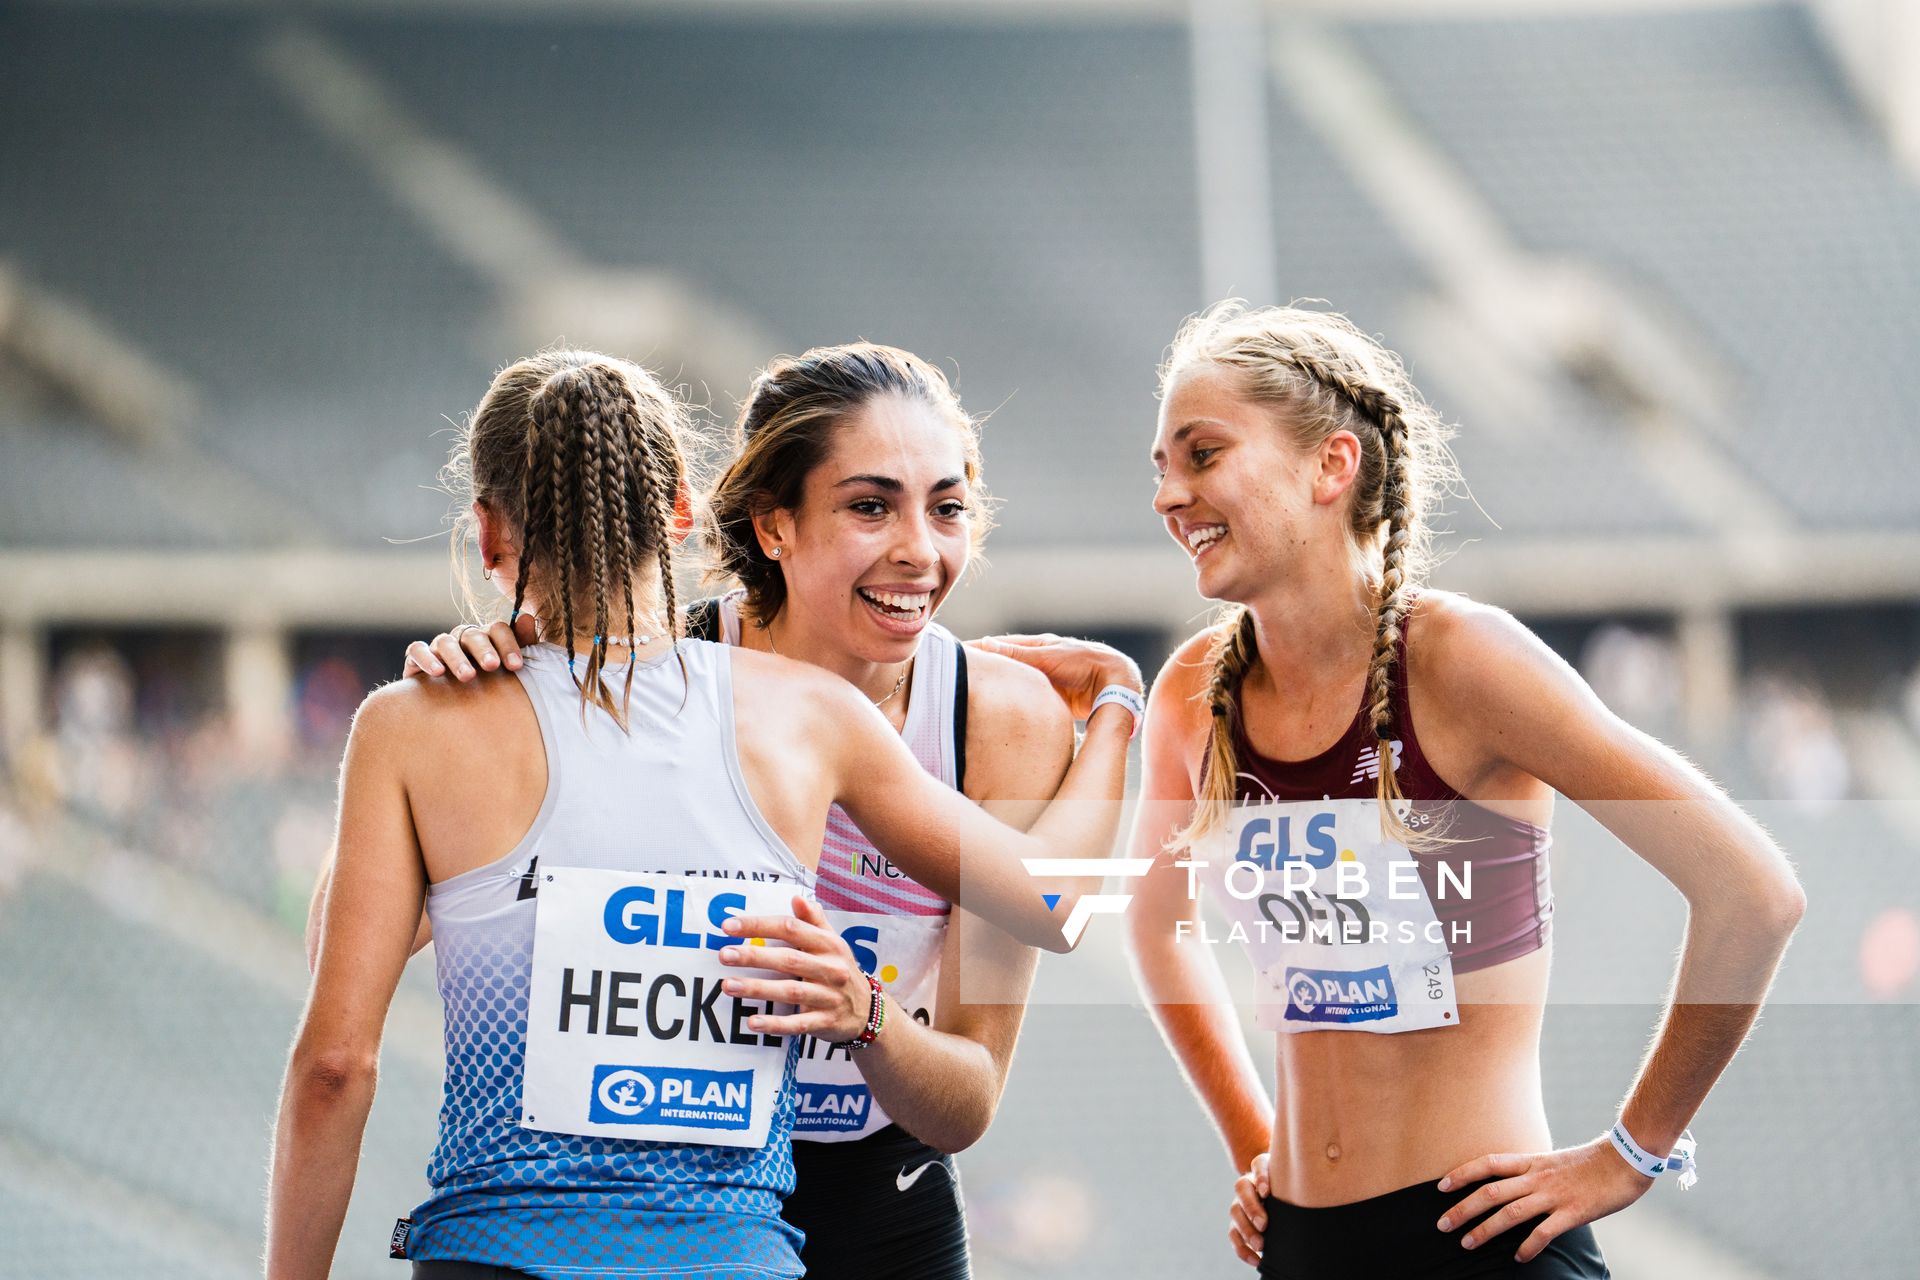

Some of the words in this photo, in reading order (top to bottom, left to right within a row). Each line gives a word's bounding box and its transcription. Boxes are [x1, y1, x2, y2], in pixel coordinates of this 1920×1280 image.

[1321, 978, 1389, 1004] PLAN
[1424, 965, 1444, 1000] 249
[1325, 1003, 1392, 1016] INTERNATIONAL
[660, 1078, 747, 1109] PLAN
[660, 1108, 745, 1123] INTERNATIONAL
[796, 1116, 859, 1127] ERNATIONAL
